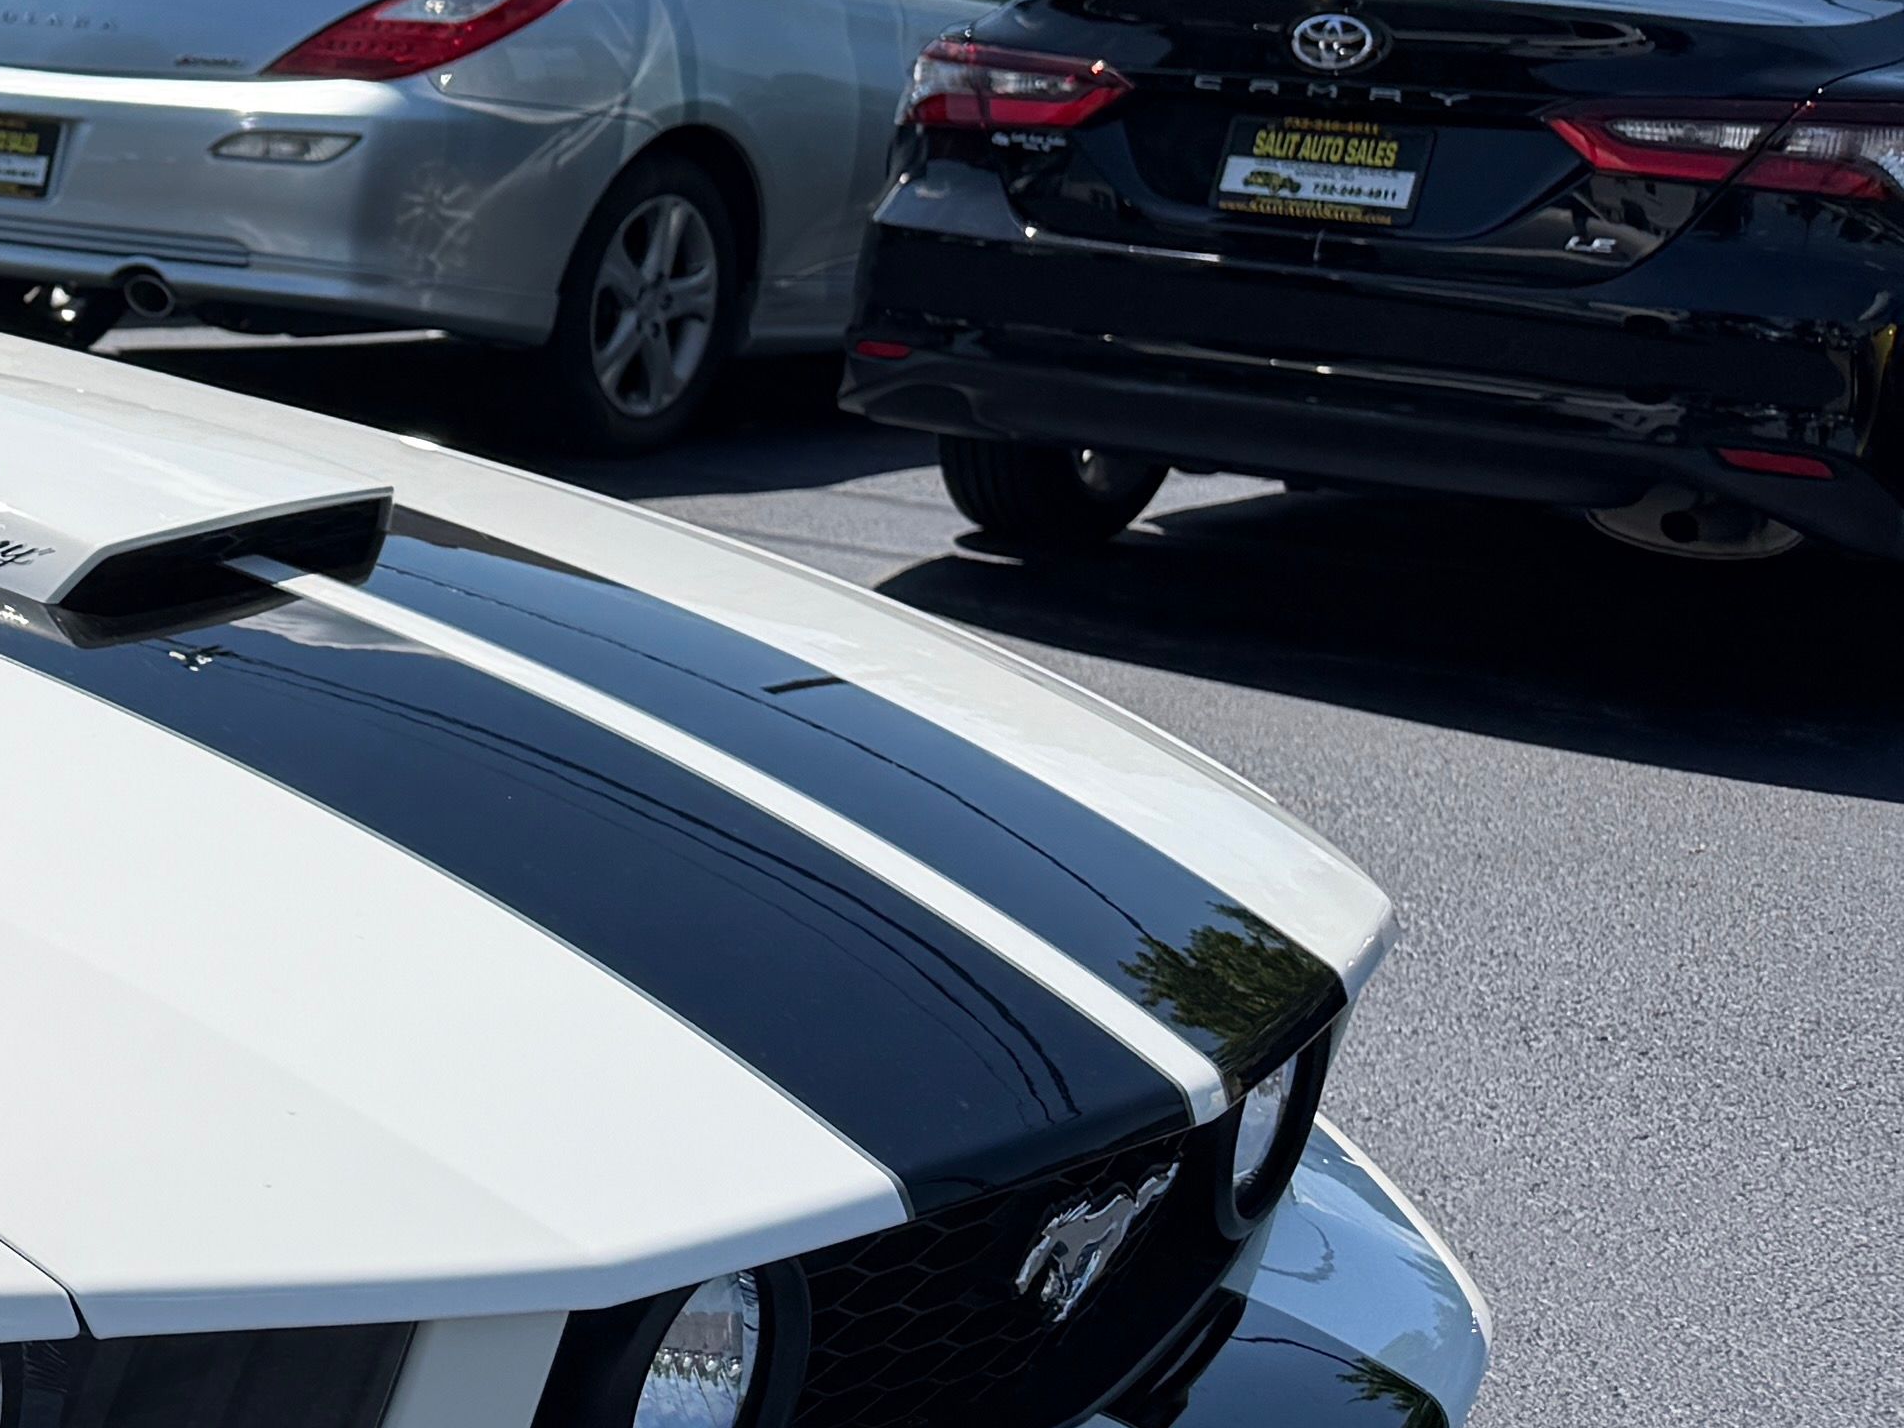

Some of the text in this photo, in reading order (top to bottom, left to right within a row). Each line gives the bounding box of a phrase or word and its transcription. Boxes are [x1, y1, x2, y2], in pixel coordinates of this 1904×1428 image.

[1194, 75, 1470, 107] CAMRY
[1253, 129, 1399, 168] SALIT AUTO SALES
[1565, 235, 1617, 254] LE
